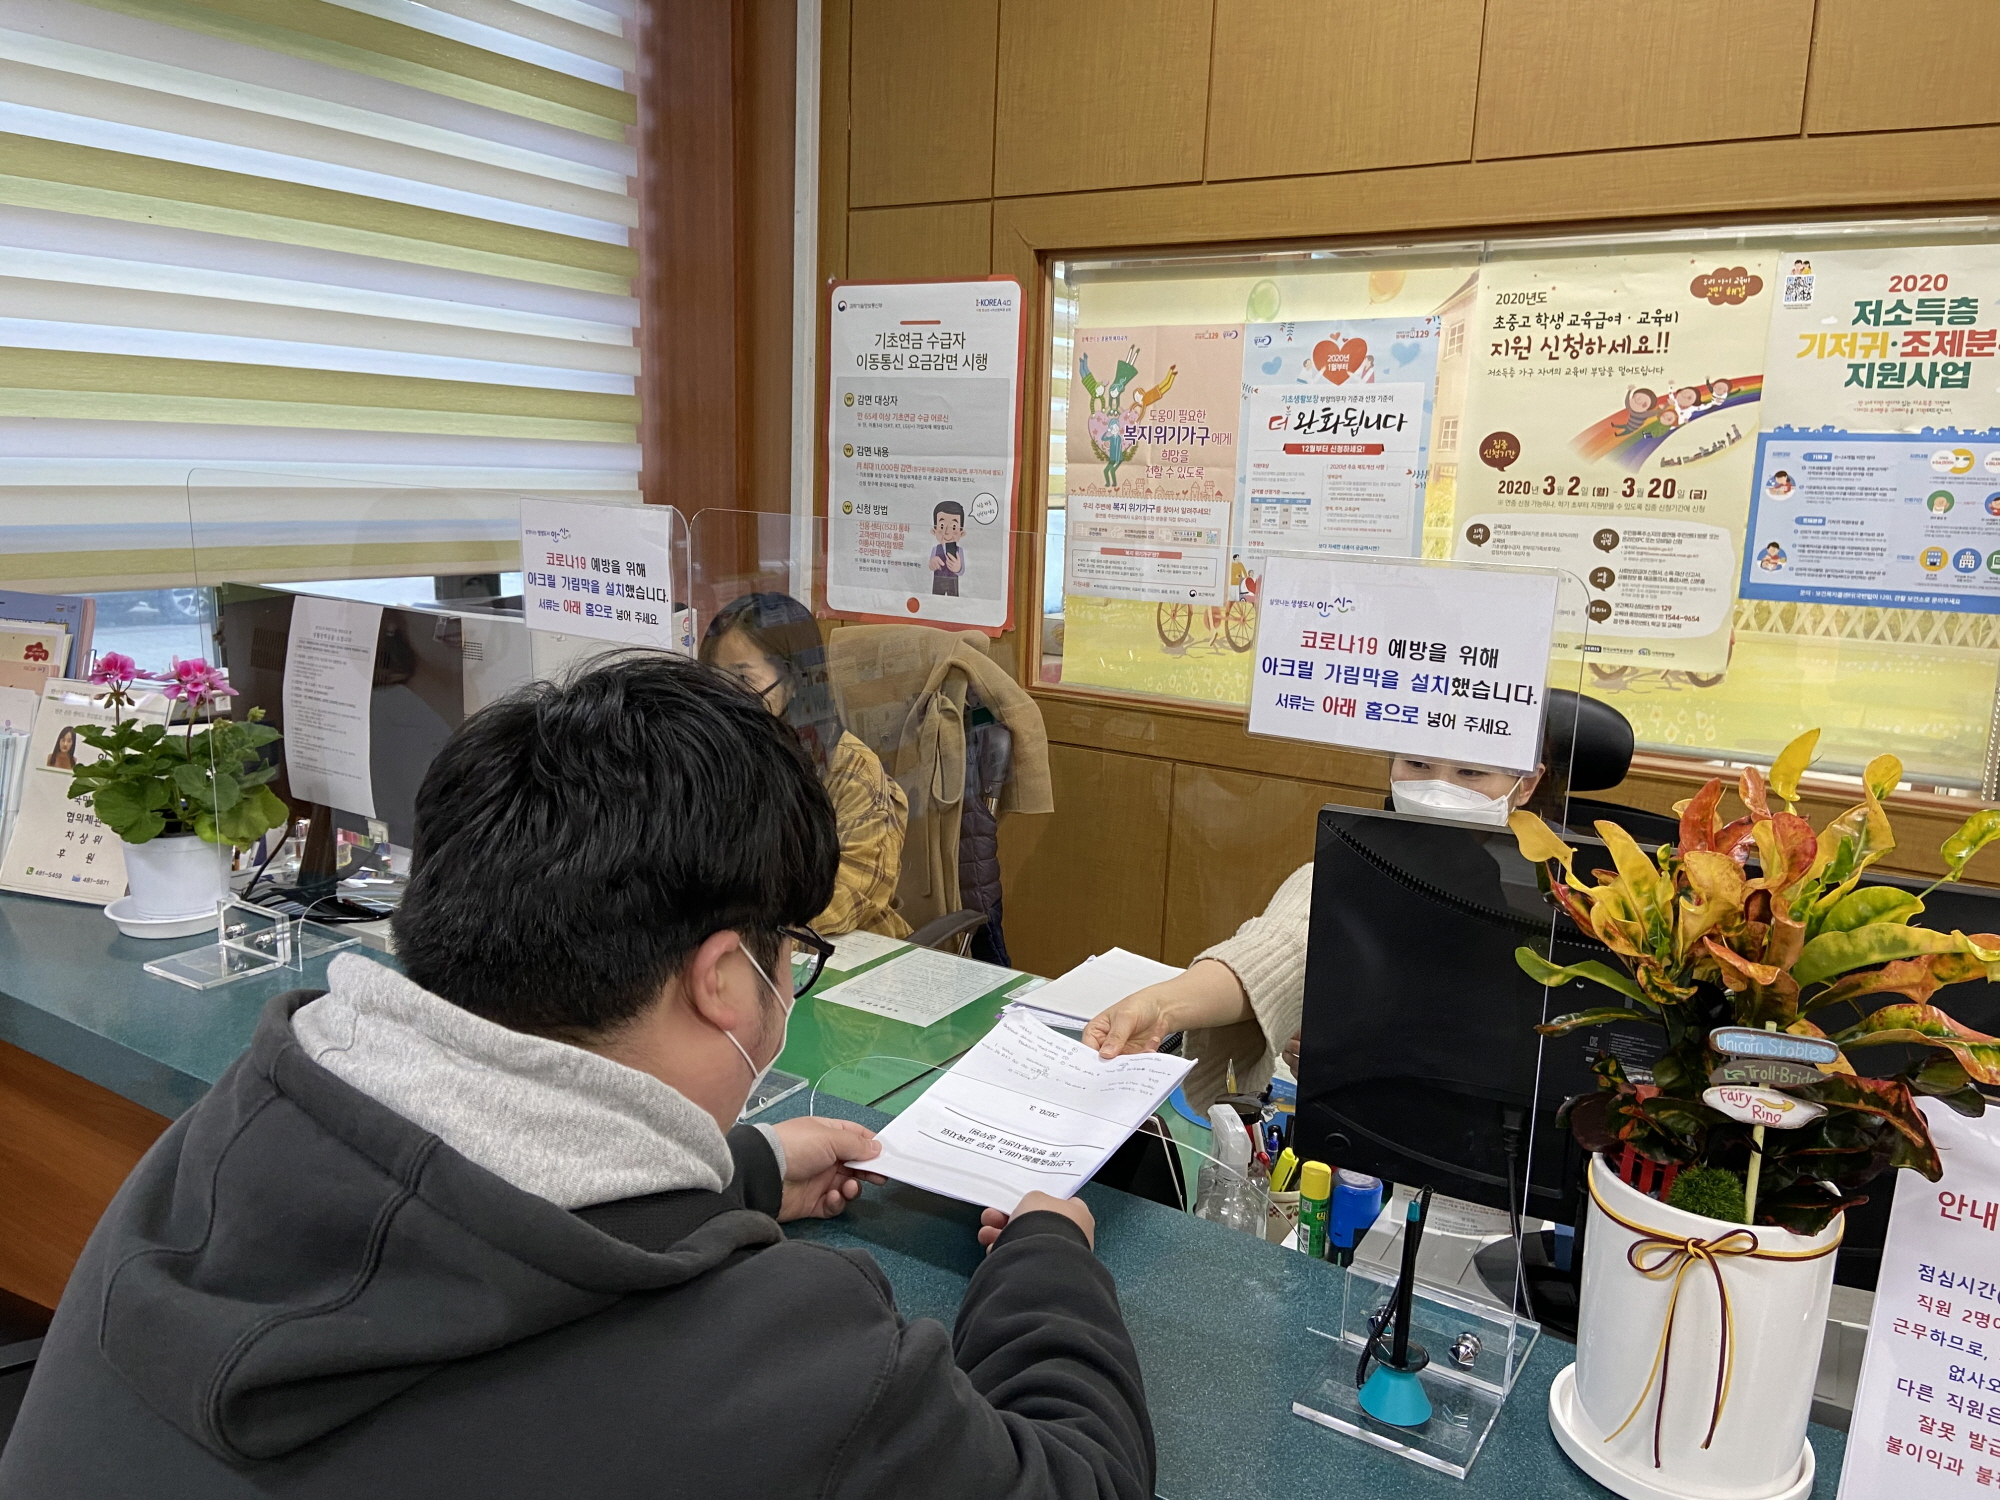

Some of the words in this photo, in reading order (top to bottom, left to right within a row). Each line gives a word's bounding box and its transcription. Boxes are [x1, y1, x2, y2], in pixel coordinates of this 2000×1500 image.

[1888, 274, 1948, 293] 2020
[1495, 292, 1547, 305] 2020년도
[1493, 313, 1531, 331] 초중고
[1536, 312, 1563, 329] 학생
[1567, 311, 1621, 329] 교육급여
[1637, 309, 1679, 327] 교육비
[1852, 297, 1978, 326] 저소득층
[875, 332, 923, 349] 기초연금
[927, 332, 965, 349] 수급자
[1415, 329, 1429, 338] 129
[1491, 335, 1532, 360] 지원
[1540, 331, 1670, 360] 신청하세요!!
[856, 353, 904, 370] 이동통신
[908, 354, 957, 370] 요금감면
[962, 353, 987, 371] 시행
[1327, 354, 1349, 363] 2020년
[1519, 368, 1534, 376] 가구
[1538, 367, 1561, 376] 자녀의
[1565, 367, 1587, 377] 교육비
[1591, 367, 1614, 377] 부담을
[1844, 362, 1972, 389] 지원사업
[857, 395, 872, 406] 감면
[875, 395, 898, 406] 대상자
[865, 412, 877, 421] 65세
[879, 412, 891, 421] 이상
[893, 413, 915, 422] 기초연금
[918, 413, 929, 422] 수급
[931, 413, 949, 423] 어르신
[1149, 410, 1176, 422] 도움이
[1179, 410, 1206, 423] 필요한
[1269, 416, 1288, 431] 더
[1293, 407, 1408, 437] 완화됩니다
[857, 446, 871, 457] 감면
[874, 446, 889, 458] 내용
[1330, 445, 1365, 453] 신청하세요!
[1484, 448, 1516, 458] 신청기간
[1493, 439, 1507, 449] 집중
[1161, 450, 1189, 463] 희망을
[1145, 466, 1163, 479] 전할
[1165, 467, 1175, 478] 수
[1177, 467, 1204, 480] 있도록
[1498, 480, 1539, 495] 2020년
[1543, 476, 1564, 496] 3월
[1567, 476, 1588, 496] 2일
[1622, 477, 1644, 498] 3월
[1648, 478, 1685, 499] 20일
[856, 503, 870, 515] 신청
[873, 504, 888, 516] 방법
[1113, 502, 1127, 512] 복지
[546, 552, 586, 569] 코로나19
[591, 557, 620, 575] 예방을
[626, 561, 646, 577] 위해
[528, 572, 556, 588] 아크릴
[561, 576, 599, 594] 가림막을
[605, 581, 668, 603] 설치했습니다.
[539, 599, 560, 612] 서류는
[563, 600, 581, 615] 아래
[586, 602, 612, 619] 홈으로
[616, 609, 631, 621] 넣어
[635, 612, 659, 625] 주세요.
[1291, 600, 1314, 608] 생생도시
[1300, 630, 1378, 655] 코로나19
[1388, 638, 1447, 663] 예방을
[1459, 645, 1499, 669] 위해
[1262, 656, 1314, 679] 아크릴
[1325, 663, 1399, 689] 가림막을
[1411, 673, 1537, 705] 설치했습니다.
[1275, 693, 1315, 713] 서류는
[1322, 695, 1357, 718] 아래
[1365, 701, 1419, 725] 홈으로
[1427, 711, 1456, 729] 넣어
[1464, 716, 1511, 736] 주세요.
[1717, 1034, 1763, 1053] Unicorn
[1768, 1039, 1828, 1059] Stables
[1719, 1088, 1752, 1108] Fairy
[1039, 1107, 1060, 1119] 2020.
[1917, 1294, 1951, 1318] 직원
[1893, 1318, 1987, 1361] 근무하므로,
[1897, 1377, 1934, 1403] 다른
[1918, 1415, 1955, 1442] 잘못
[1886, 1435, 1964, 1476] 불이익과
